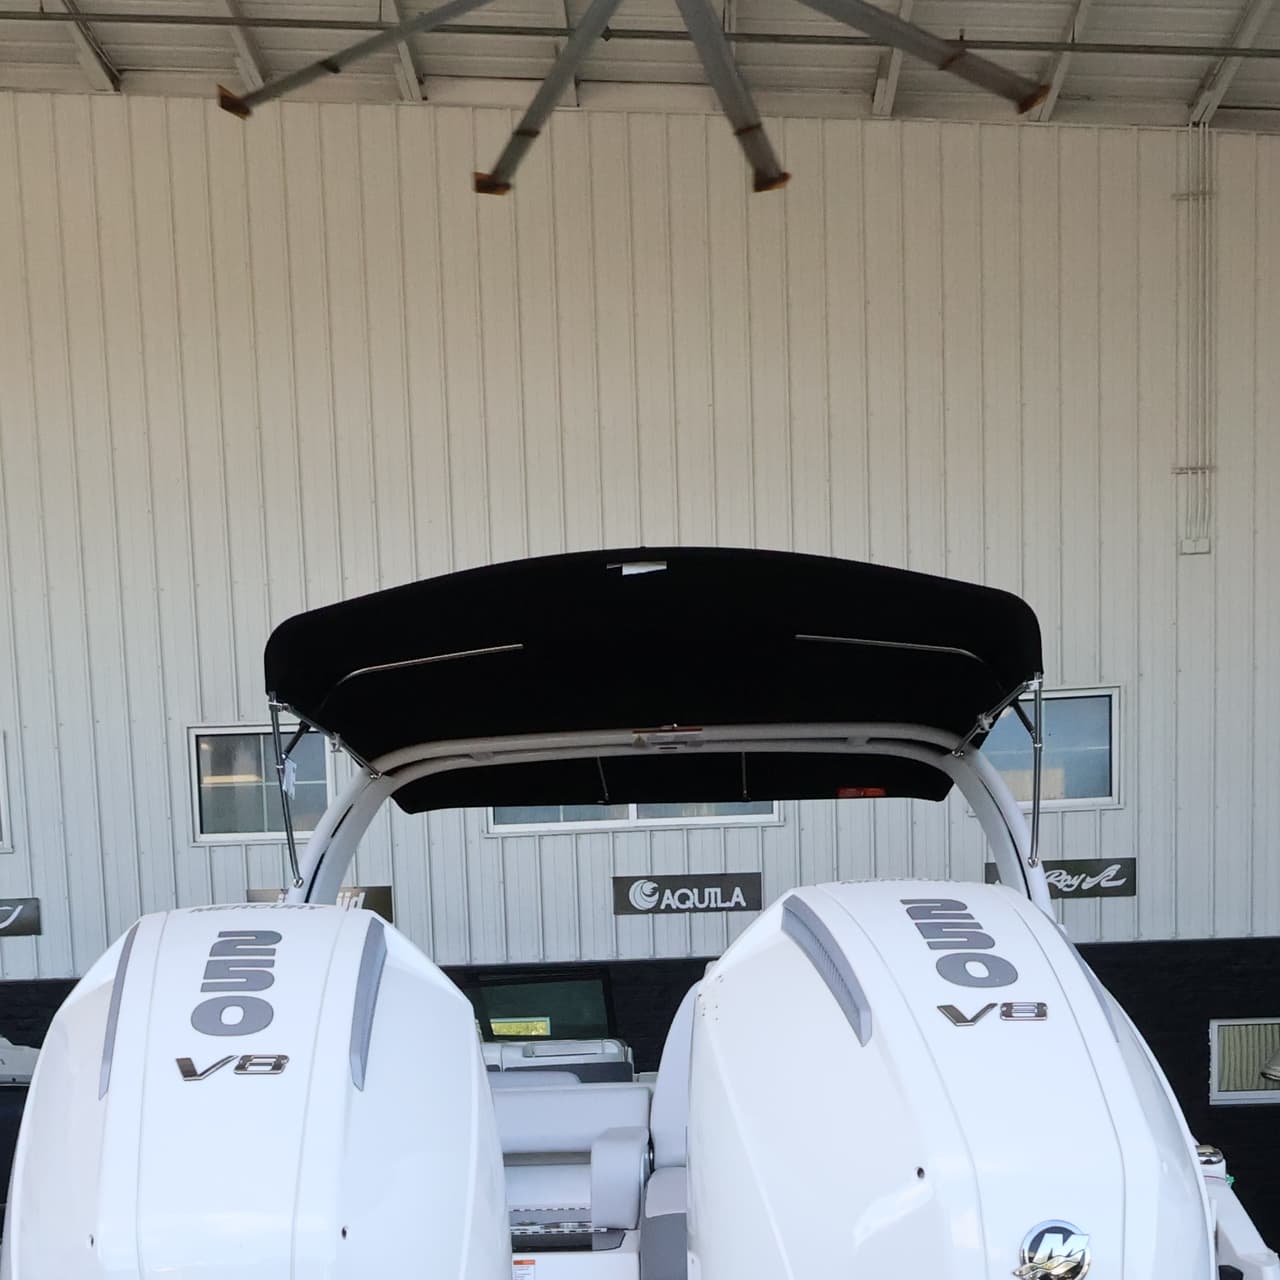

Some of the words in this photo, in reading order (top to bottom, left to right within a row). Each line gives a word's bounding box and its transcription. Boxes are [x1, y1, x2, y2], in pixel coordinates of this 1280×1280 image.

[659, 886, 747, 910] AQUILA
[899, 898, 1019, 989] 250
[190, 930, 283, 1037] 250
[936, 1001, 1049, 1027] V8
[175, 1054, 290, 1082] V8
